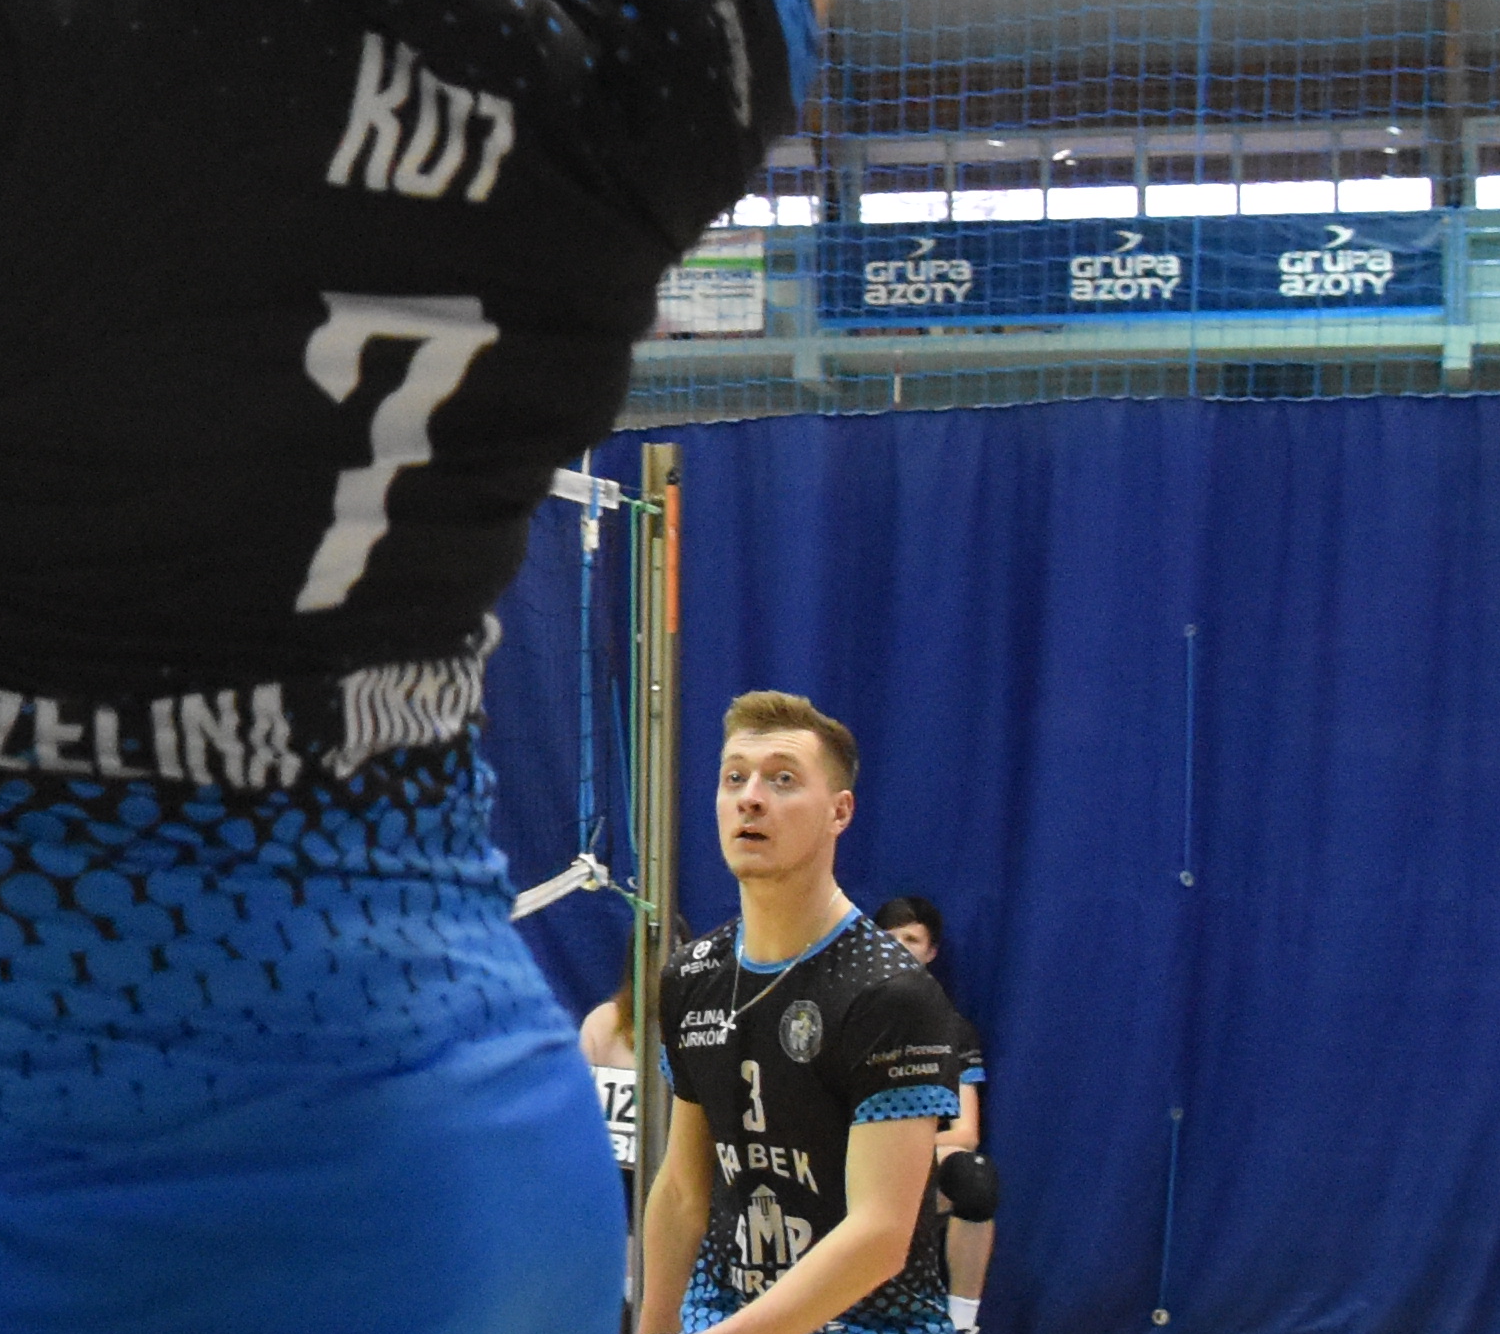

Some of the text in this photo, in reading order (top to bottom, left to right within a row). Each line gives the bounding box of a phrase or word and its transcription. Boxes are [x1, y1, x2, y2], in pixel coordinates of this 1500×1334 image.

[296, 292, 500, 613] 7
[678, 1027, 729, 1049] URKÓW
[681, 1008, 727, 1028] ELINA
[603, 1081, 636, 1123] 12
[740, 1059, 767, 1133] 3
